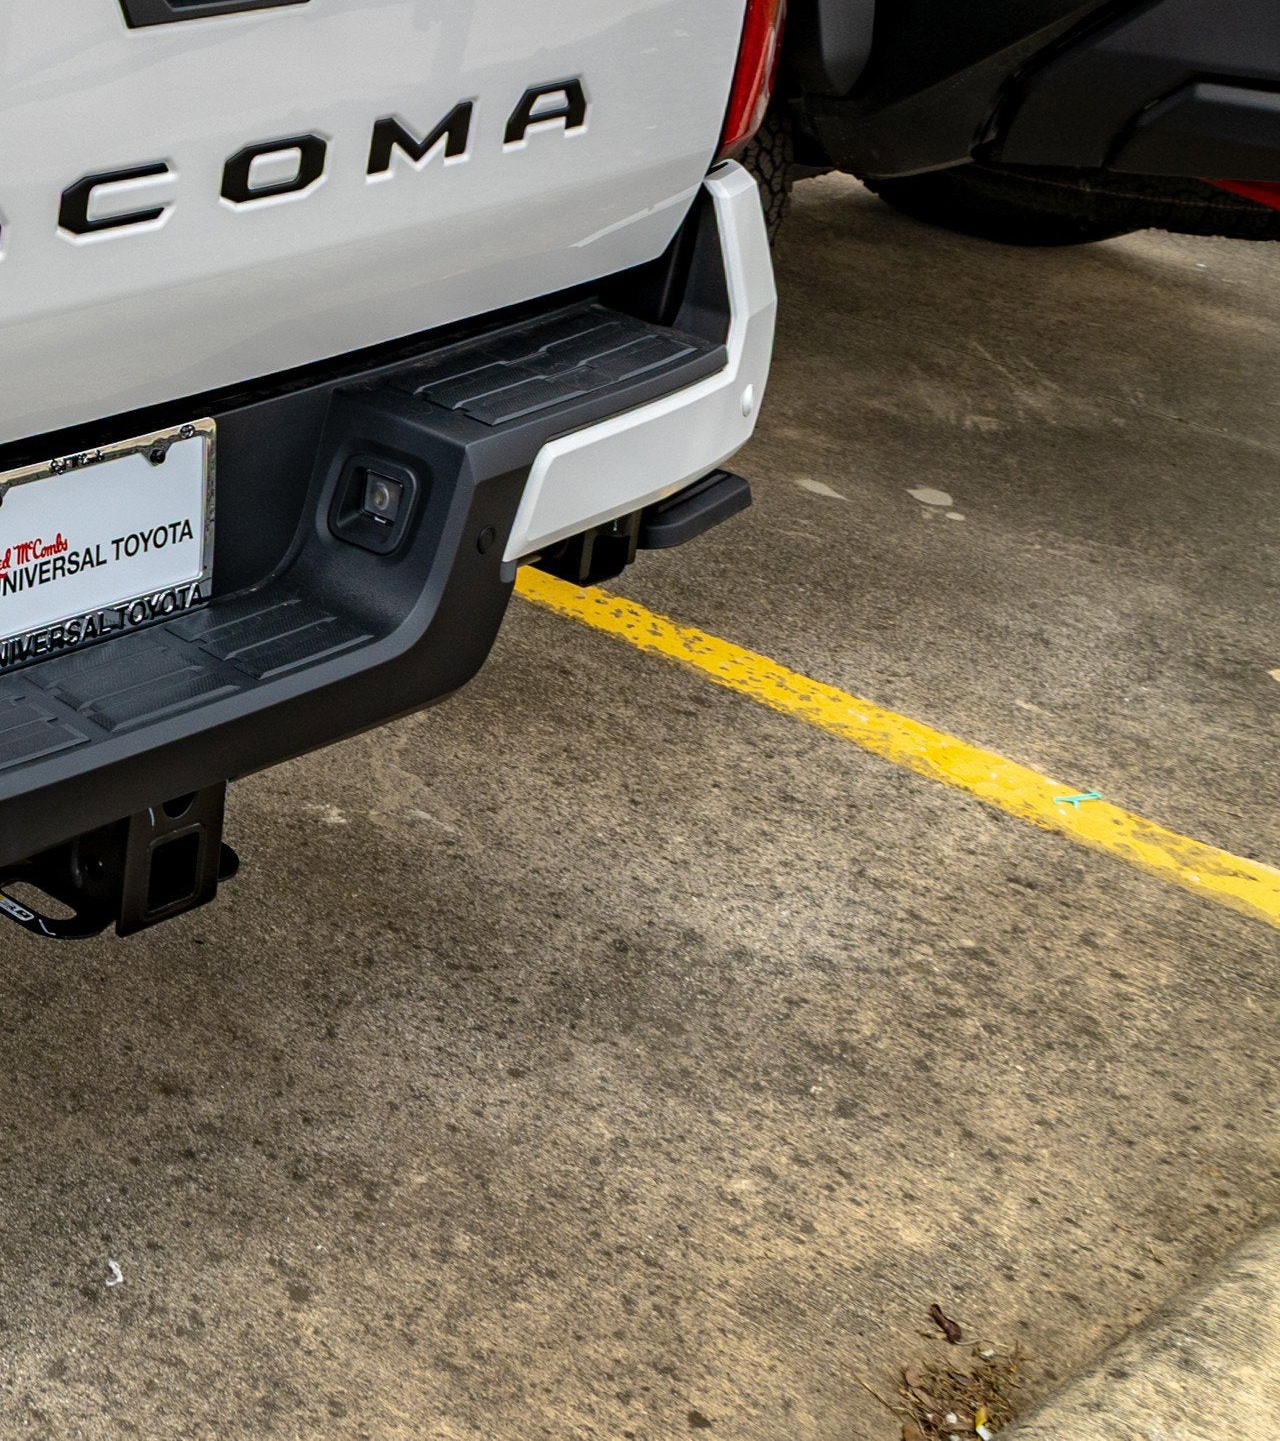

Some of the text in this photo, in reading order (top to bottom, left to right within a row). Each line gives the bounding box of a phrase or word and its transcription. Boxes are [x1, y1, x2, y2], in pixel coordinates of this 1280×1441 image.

[14, 533, 68, 563] McCombs
[111, 519, 193, 561] TOYOTA
[114, 582, 203, 630] TOYOTA
